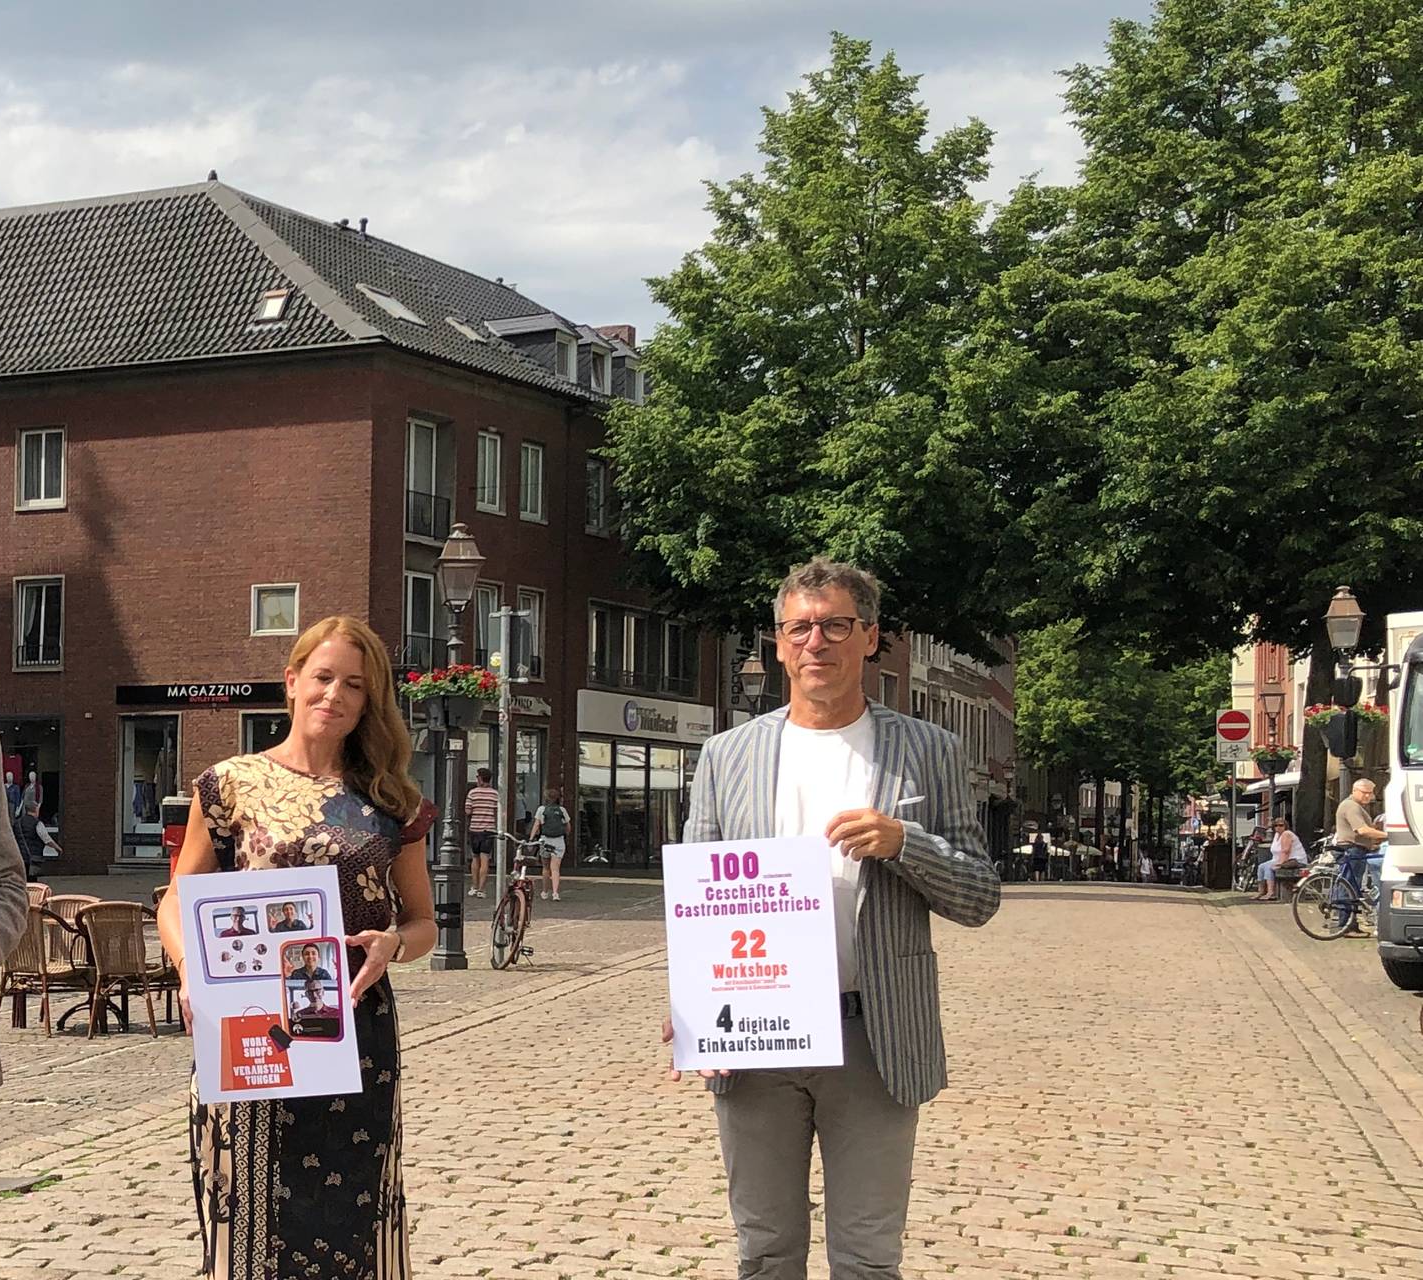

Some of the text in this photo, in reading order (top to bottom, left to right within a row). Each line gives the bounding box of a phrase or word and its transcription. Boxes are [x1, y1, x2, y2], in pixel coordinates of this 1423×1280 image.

[167, 684, 252, 697] MAGAZZINO
[710, 851, 759, 882] 100
[705, 882, 790, 900] Geschäfte &
[674, 896, 821, 918] Gastronomiebetriebe
[730, 929, 767, 959] 22
[712, 962, 788, 980] Workshops
[716, 1004, 790, 1035] 4 digitale
[241, 1037, 271, 1047] WORK-
[697, 1035, 812, 1053] Einkaufsbummel
[243, 1046, 273, 1057] SHOPS
[233, 1064, 289, 1076] VERANSTAL-
[244, 1075, 280, 1085] TUNGEN
